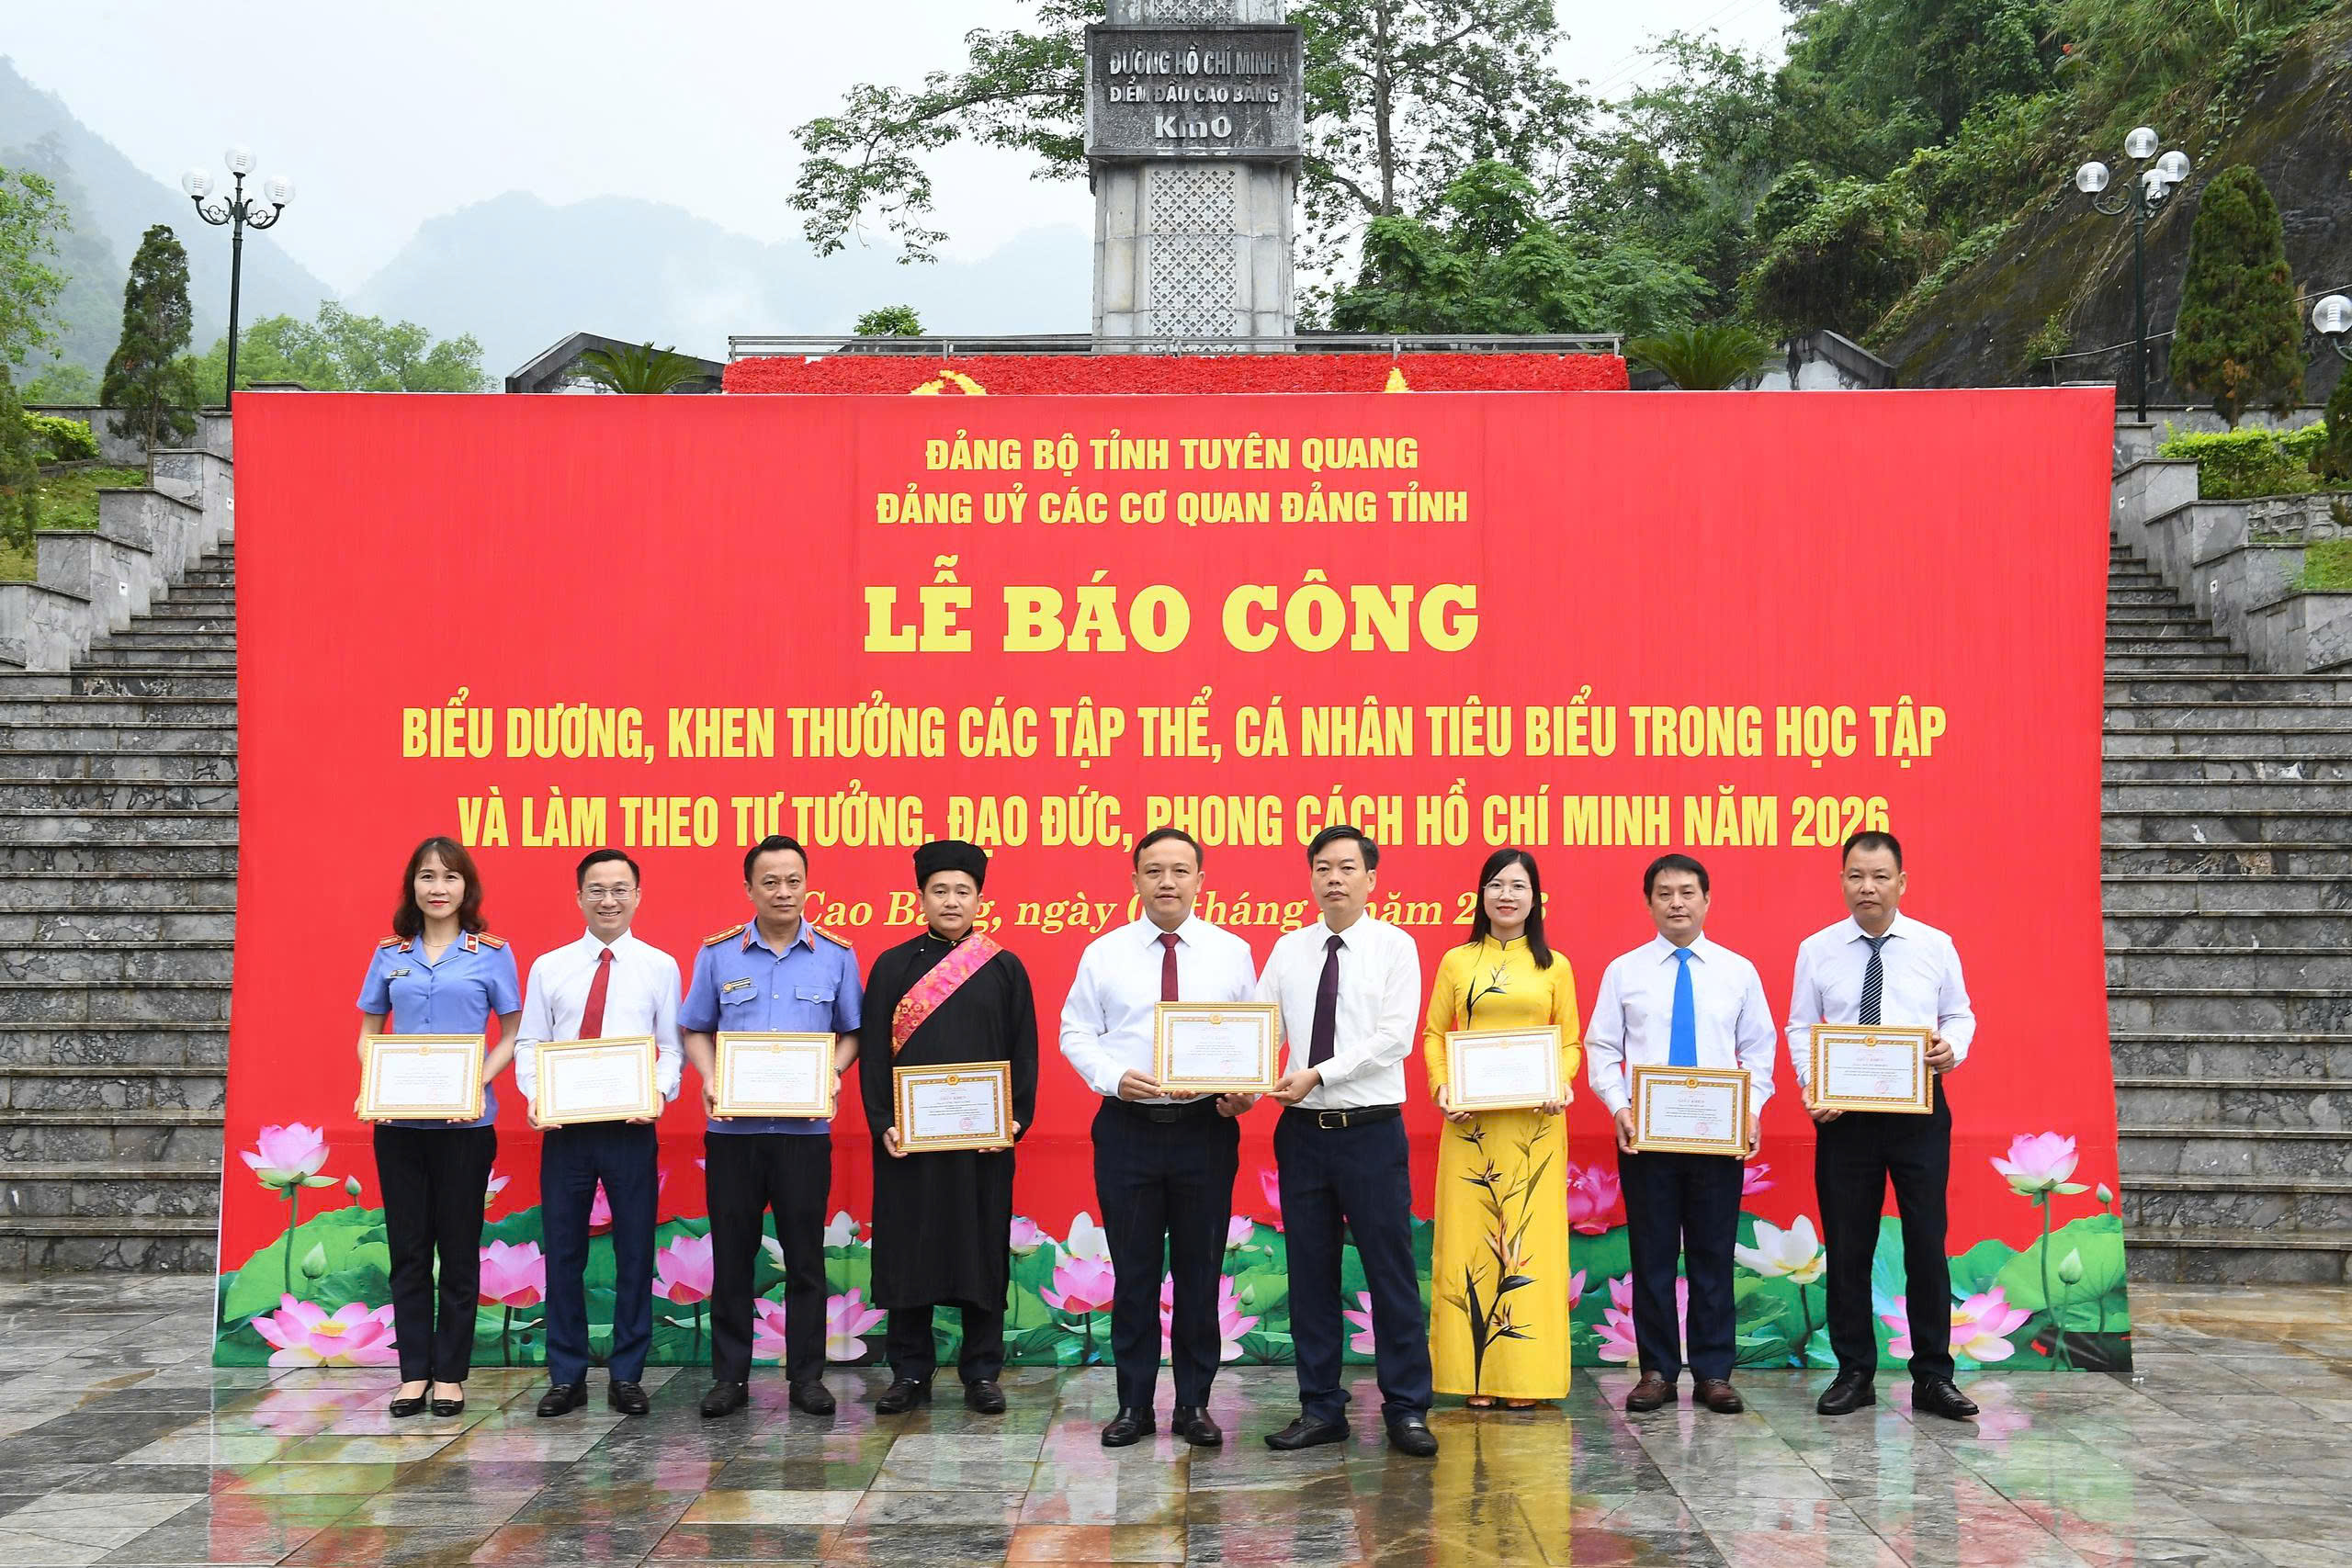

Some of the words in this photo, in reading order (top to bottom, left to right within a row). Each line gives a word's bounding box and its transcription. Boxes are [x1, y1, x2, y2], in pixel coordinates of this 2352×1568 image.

[1110, 43, 1170, 74] ĐƯỜNG
[1175, 41, 1199, 74] HỒ
[1203, 45, 1231, 74] CHÍ
[1236, 51, 1278, 74] MINH
[1110, 75, 1150, 102] ĐIỂM
[1154, 77, 1190, 102] ĐẦU
[1193, 86, 1229, 103] CAO
[1233, 75, 1279, 103] BẰNG
[925, 428, 1022, 470] ĐẢNG
[1033, 433, 1080, 478] BỘ
[1089, 428, 1170, 470] TỈNH
[1179, 432, 1290, 470] TUYÊN
[1301, 436, 1419, 473] QUANG
[876, 482, 972, 525] ĐẢNG
[984, 481, 1028, 525] UỶ
[1038, 486, 1108, 525] CÁC
[1119, 489, 1167, 525] CƠ
[1177, 491, 1270, 527] QUAN
[1280, 480, 1377, 523] ĐẢNG
[1387, 480, 1468, 523] TỈNH
[864, 554, 972, 652] LỄ
[1002, 570, 1191, 653] BÁO
[1222, 569, 1479, 653] CÔNG
[402, 686, 493, 758] BIỂU
[506, 702, 655, 765] DƯƠNG,
[668, 707, 775, 758] KHEN
[786, 690, 945, 758] THƯỞNG
[958, 695, 1038, 758] CÁC
[1050, 695, 1125, 769] TẬP
[1136, 685, 1222, 763] THỂ,
[1235, 695, 1289, 758] CÁ
[1301, 694, 1413, 757] NHÂN
[1425, 694, 1512, 757] TIÊU
[1525, 684, 1617, 757] BIỂU
[1628, 705, 1762, 758] TRONG
[1776, 705, 1857, 769] HỌC
[1869, 694, 1947, 769] TẬP
[458, 785, 510, 847] VÀ
[521, 785, 606, 847] LÀM
[618, 795, 718, 848] THEO
[730, 791, 785, 847] TƯ
[946, 795, 1028, 858] ĐẠO
[1039, 784, 1133, 853] ĐỨC,
[1145, 795, 1283, 847] PHONG
[1295, 784, 1403, 846] CÁCH
[1416, 778, 1469, 846] HỒ
[1482, 784, 1550, 846] CHÍ
[1563, 795, 1670, 846] MINH
[1683, 784, 1778, 846] NĂM
[1791, 795, 1890, 847] 2026
[800, 890, 873, 926] Cao
[1013, 891, 1118, 934] ngày
